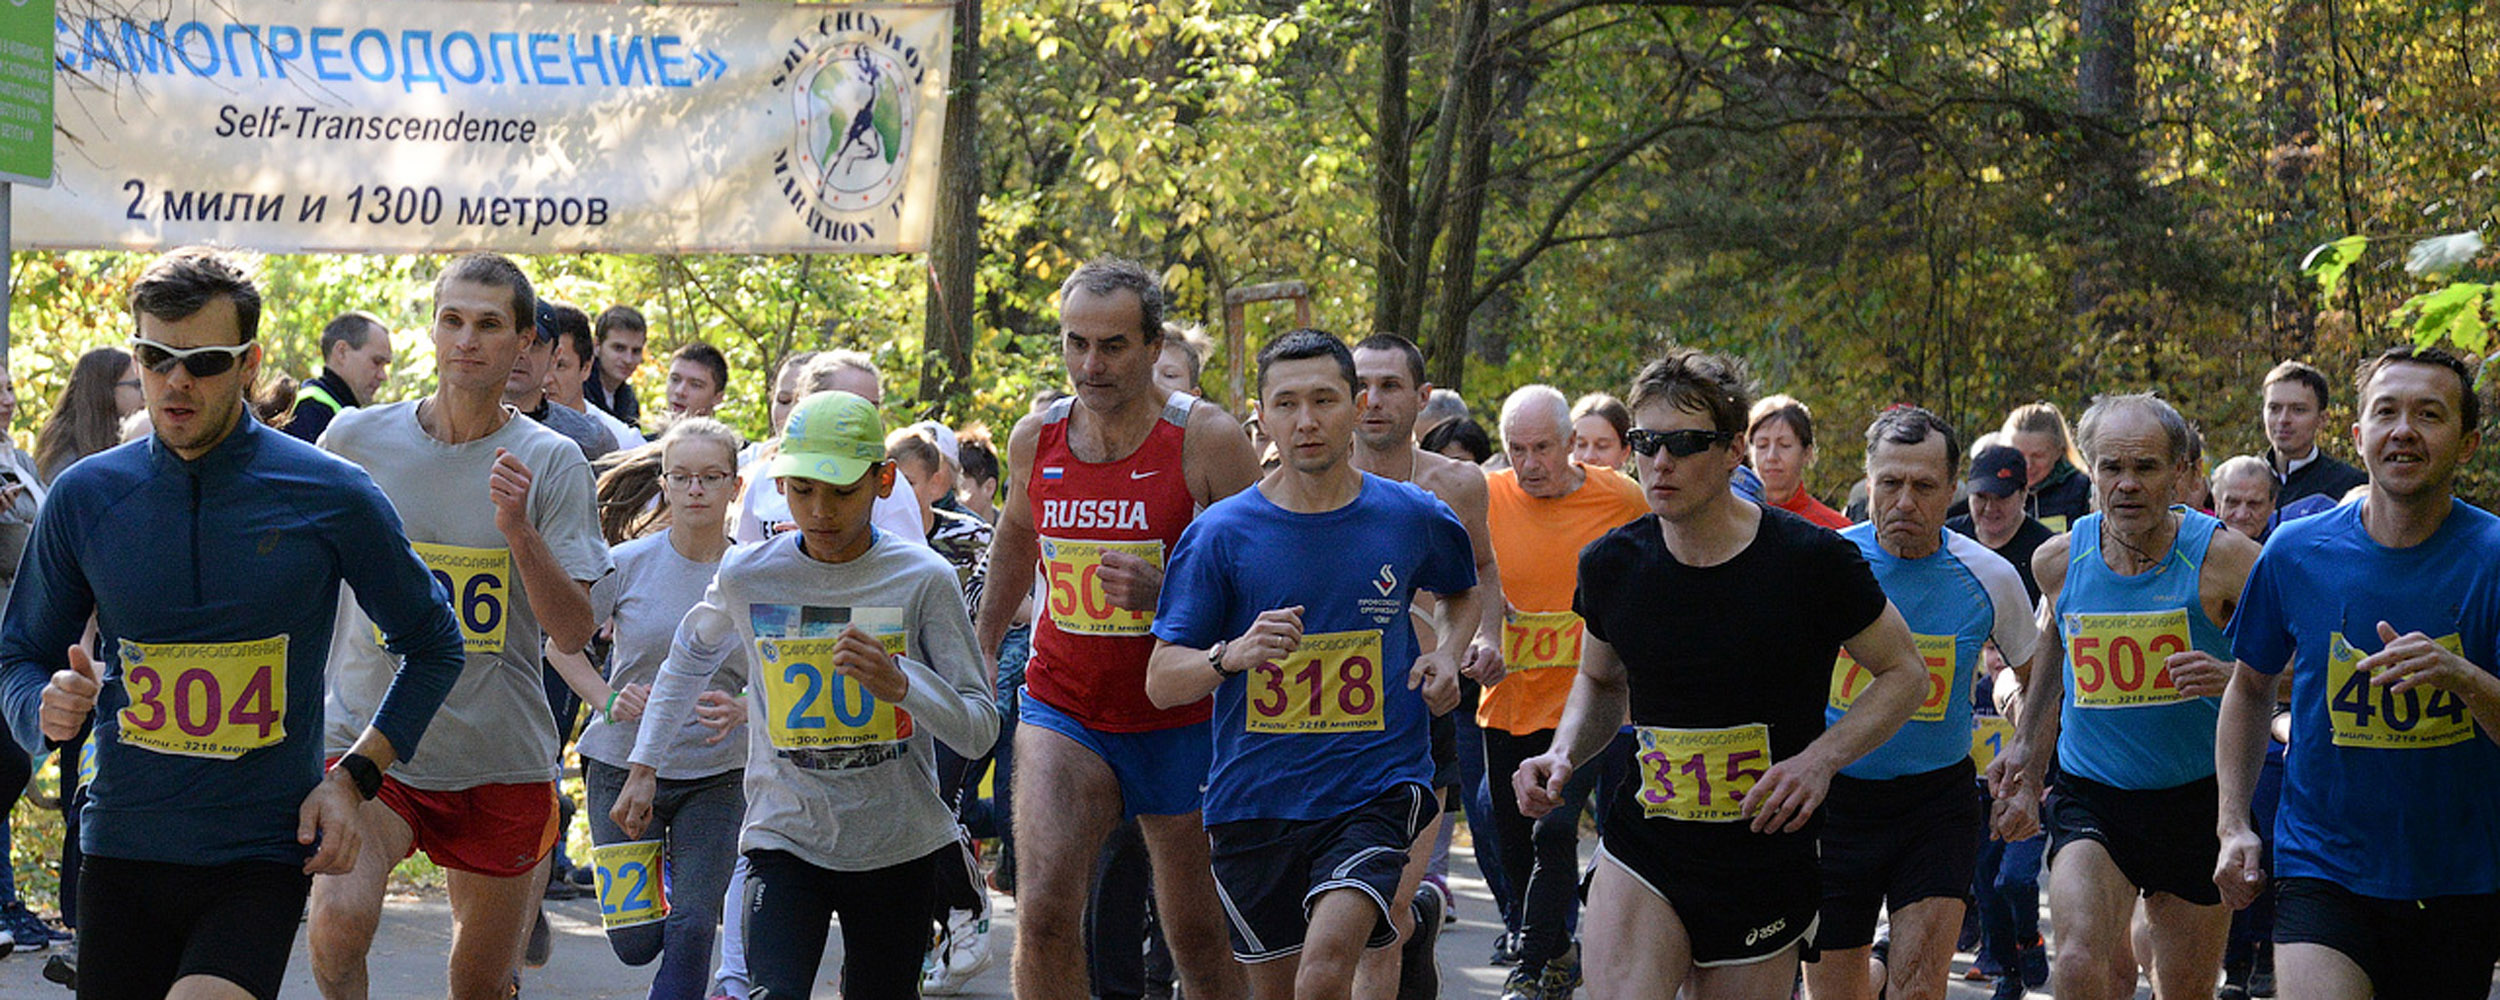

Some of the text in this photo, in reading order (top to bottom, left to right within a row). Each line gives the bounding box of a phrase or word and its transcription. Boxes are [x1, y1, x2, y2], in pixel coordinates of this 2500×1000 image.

[772, 11, 924, 88] SRI CHINMOY
[216, 105, 537, 144] Self-Transcendence
[123, 180, 609, 237] 2 мили и 1300 метров
[773, 147, 876, 243] MARATHON
[1042, 500, 1149, 530] RUSSIA
[1050, 561, 1143, 620] 50
[1506, 620, 1584, 663] 701
[2073, 634, 2186, 694] 502
[124, 666, 280, 738] 304
[784, 662, 875, 729] 20
[1254, 656, 1376, 717] 318
[2332, 668, 2468, 732] 404
[183, 741, 217, 753] 3218
[822, 733, 879, 745] метров
[1298, 720, 1328, 729] 3218
[1330, 719, 1379, 729] метров
[1642, 750, 1766, 806] 315
[597, 861, 652, 915] 22
